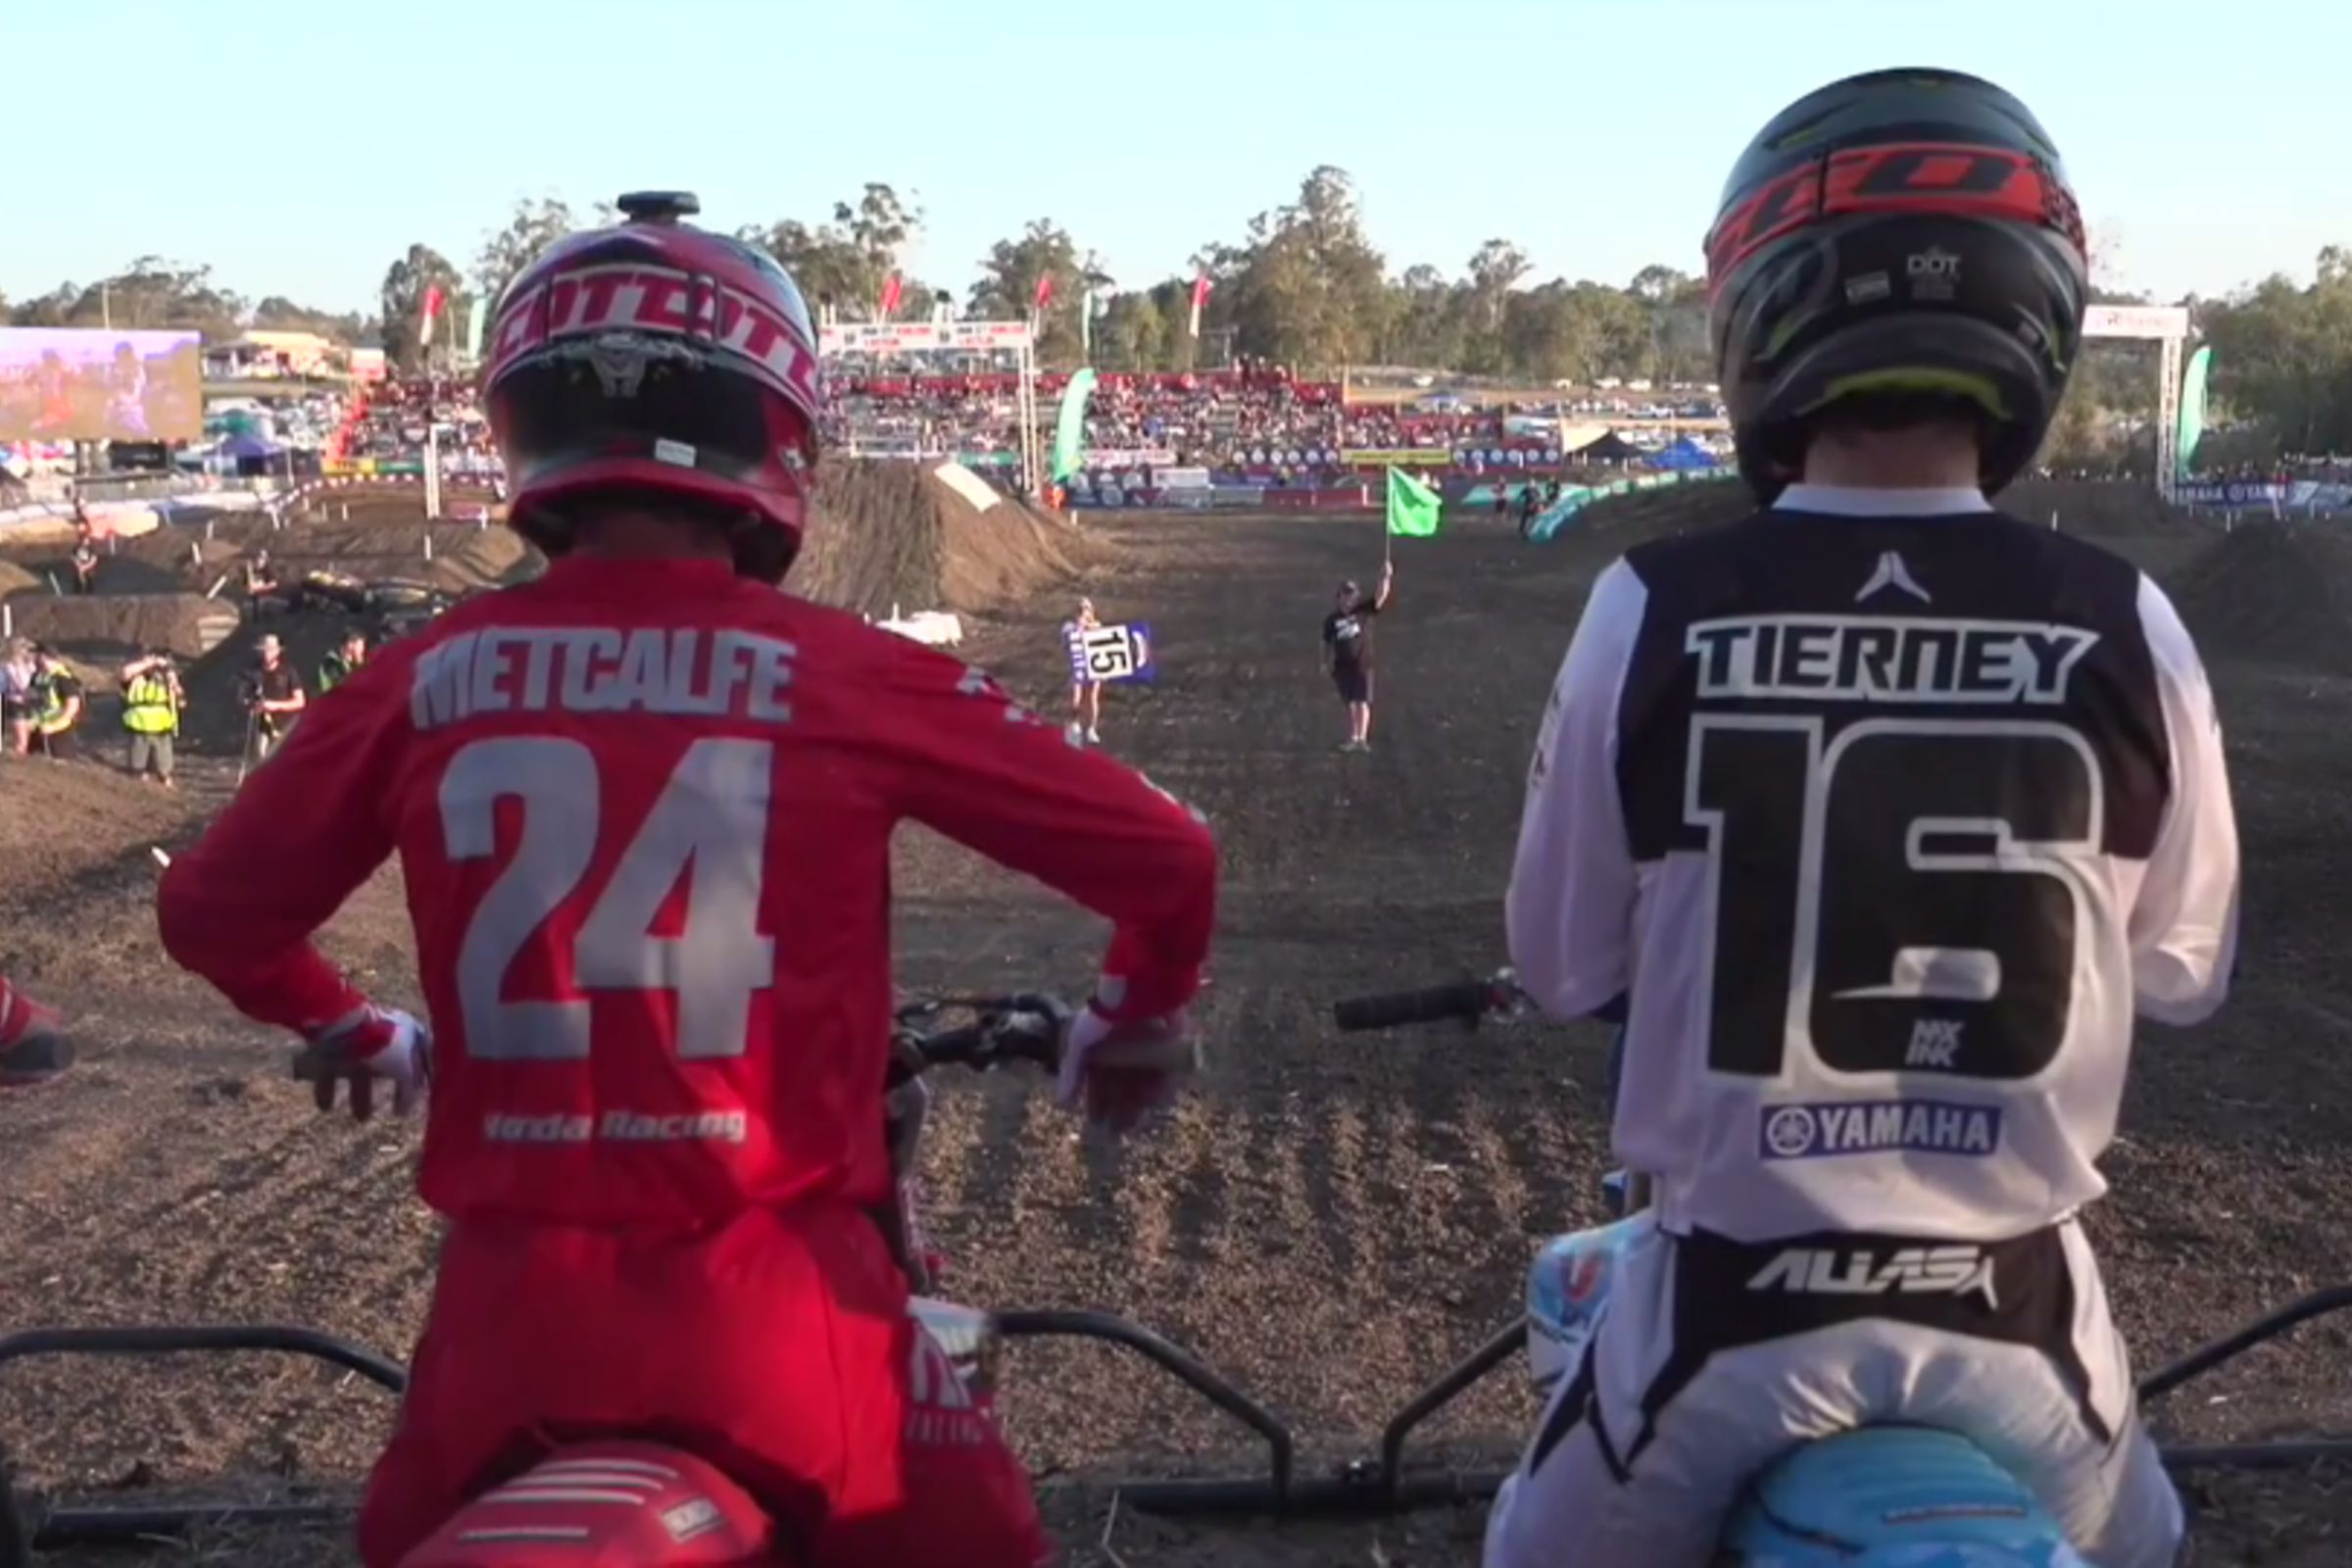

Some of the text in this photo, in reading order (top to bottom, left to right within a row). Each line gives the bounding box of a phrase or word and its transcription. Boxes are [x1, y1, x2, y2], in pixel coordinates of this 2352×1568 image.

[1907, 254, 1960, 273] DOT
[411, 625, 797, 729] METCALFE
[1086, 630, 1127, 674] 15
[1685, 614, 2100, 704] TIERNEY
[438, 735, 775, 1058] 24
[1684, 712, 2104, 1086] 16
[599, 1108, 747, 1144] Racing
[1819, 1104, 1991, 1151] YAMAHA
